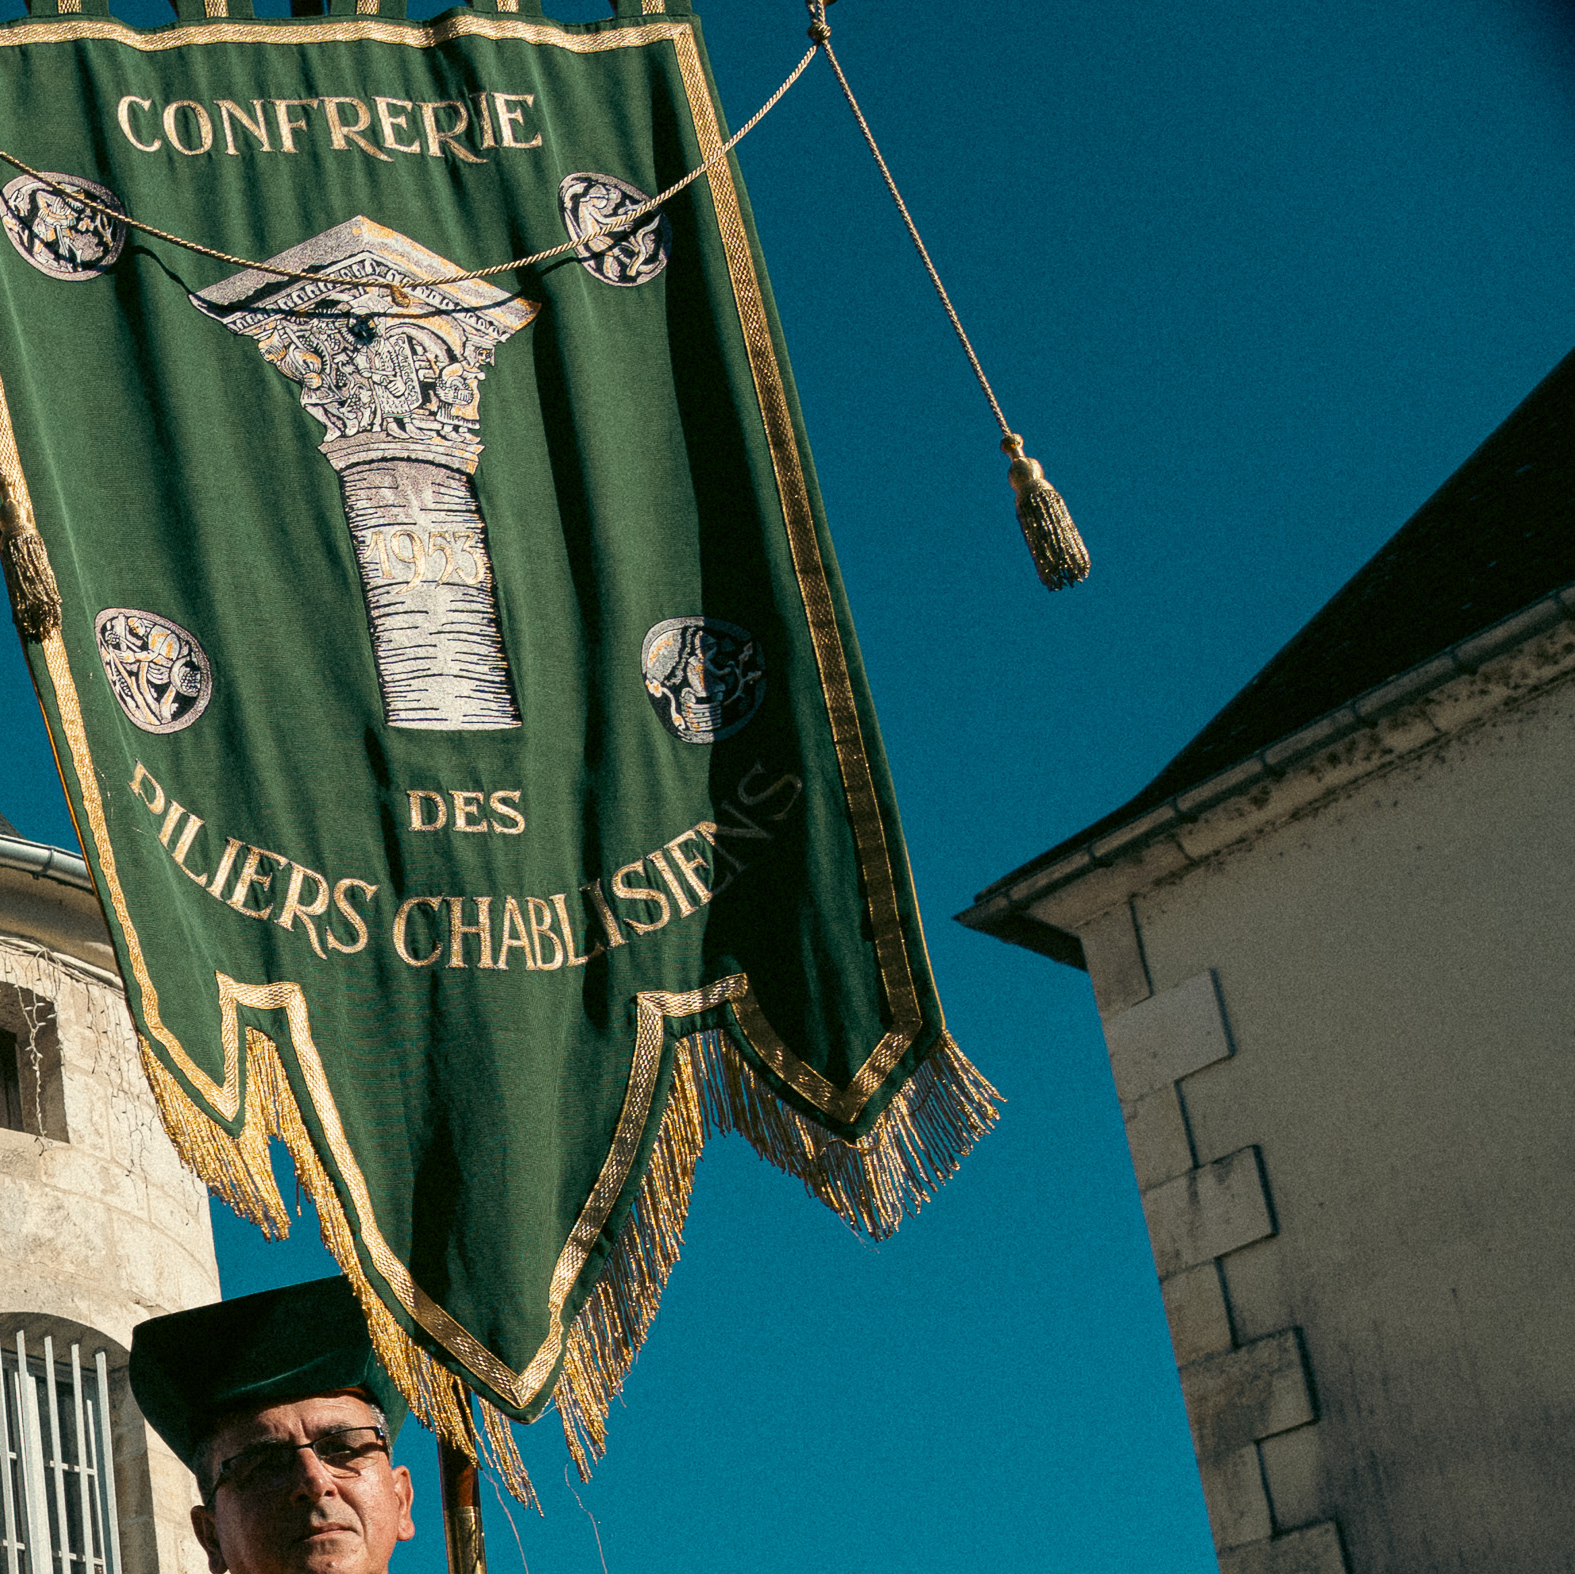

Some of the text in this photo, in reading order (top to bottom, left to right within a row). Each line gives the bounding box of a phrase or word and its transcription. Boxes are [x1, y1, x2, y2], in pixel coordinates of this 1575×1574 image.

[117, 92, 543, 163] CONFRERIE
[362, 529, 485, 595] 1953
[407, 789, 526, 835] DES
[128, 757, 802, 971] PILIERS CHABLISIENS
